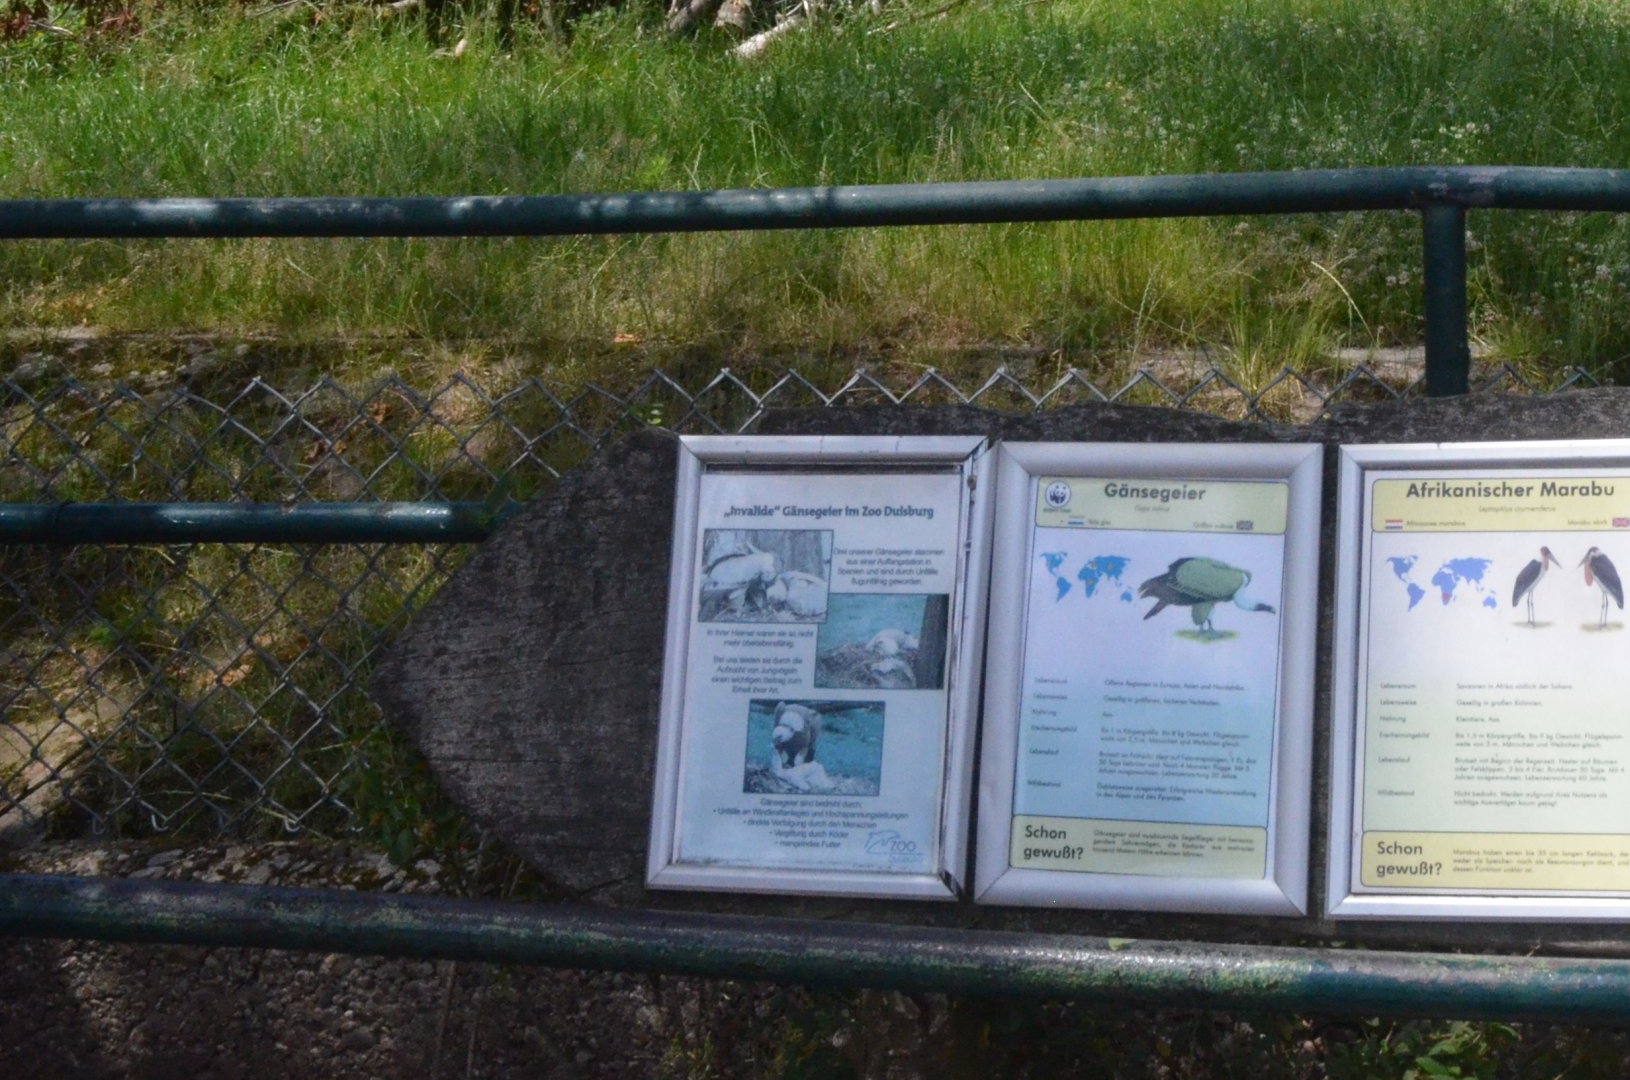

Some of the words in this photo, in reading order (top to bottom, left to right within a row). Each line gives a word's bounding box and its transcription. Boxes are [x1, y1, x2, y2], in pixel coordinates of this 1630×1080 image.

[1105, 483, 1206, 502] Gänsegeier
[1406, 482, 1534, 498] Afrikanischer
[1540, 482, 1615, 497] Marabu
[783, 505, 842, 520] Gänsegeier
[846, 506, 861, 517] im
[862, 506, 882, 517] Zoo
[884, 505, 934, 520] Duisburg
[1025, 825, 1067, 840] Schon
[1023, 846, 1084, 861] gewußt?
[1377, 841, 1423, 855] Schon
[1376, 863, 1443, 878] gewußt?
